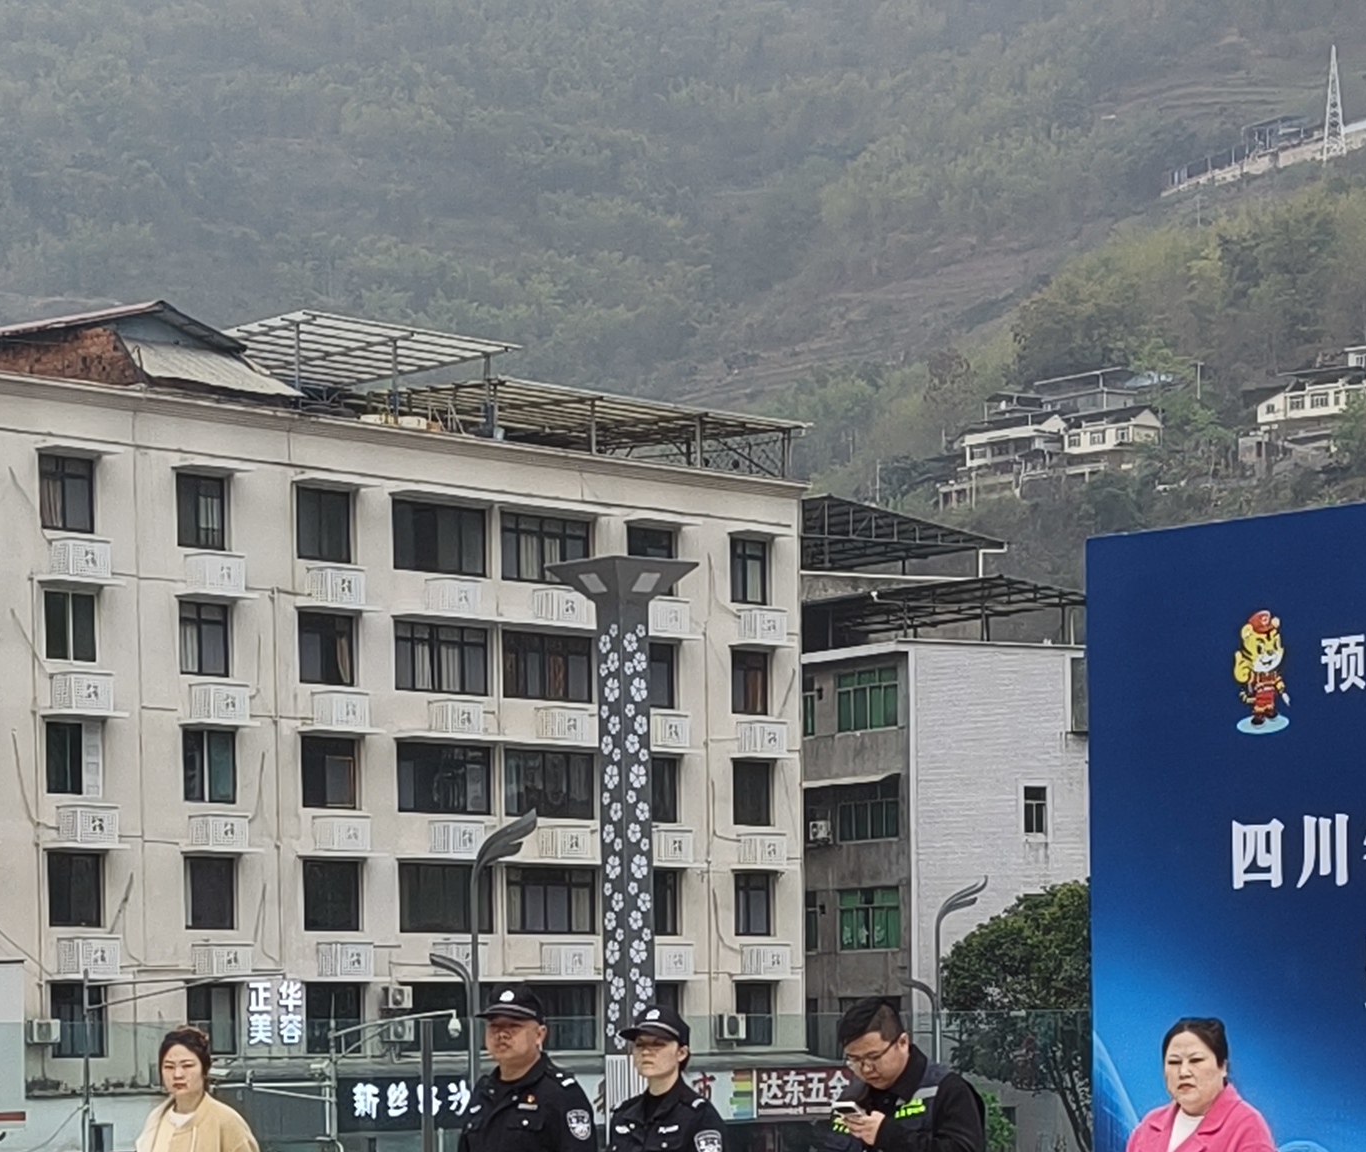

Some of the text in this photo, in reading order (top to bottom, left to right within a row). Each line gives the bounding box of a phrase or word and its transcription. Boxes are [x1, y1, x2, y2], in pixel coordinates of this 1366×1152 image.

[248, 980, 302, 1012] 正华
[248, 1013, 302, 1045] 美容
[759, 1069, 850, 1106] 达东五金
